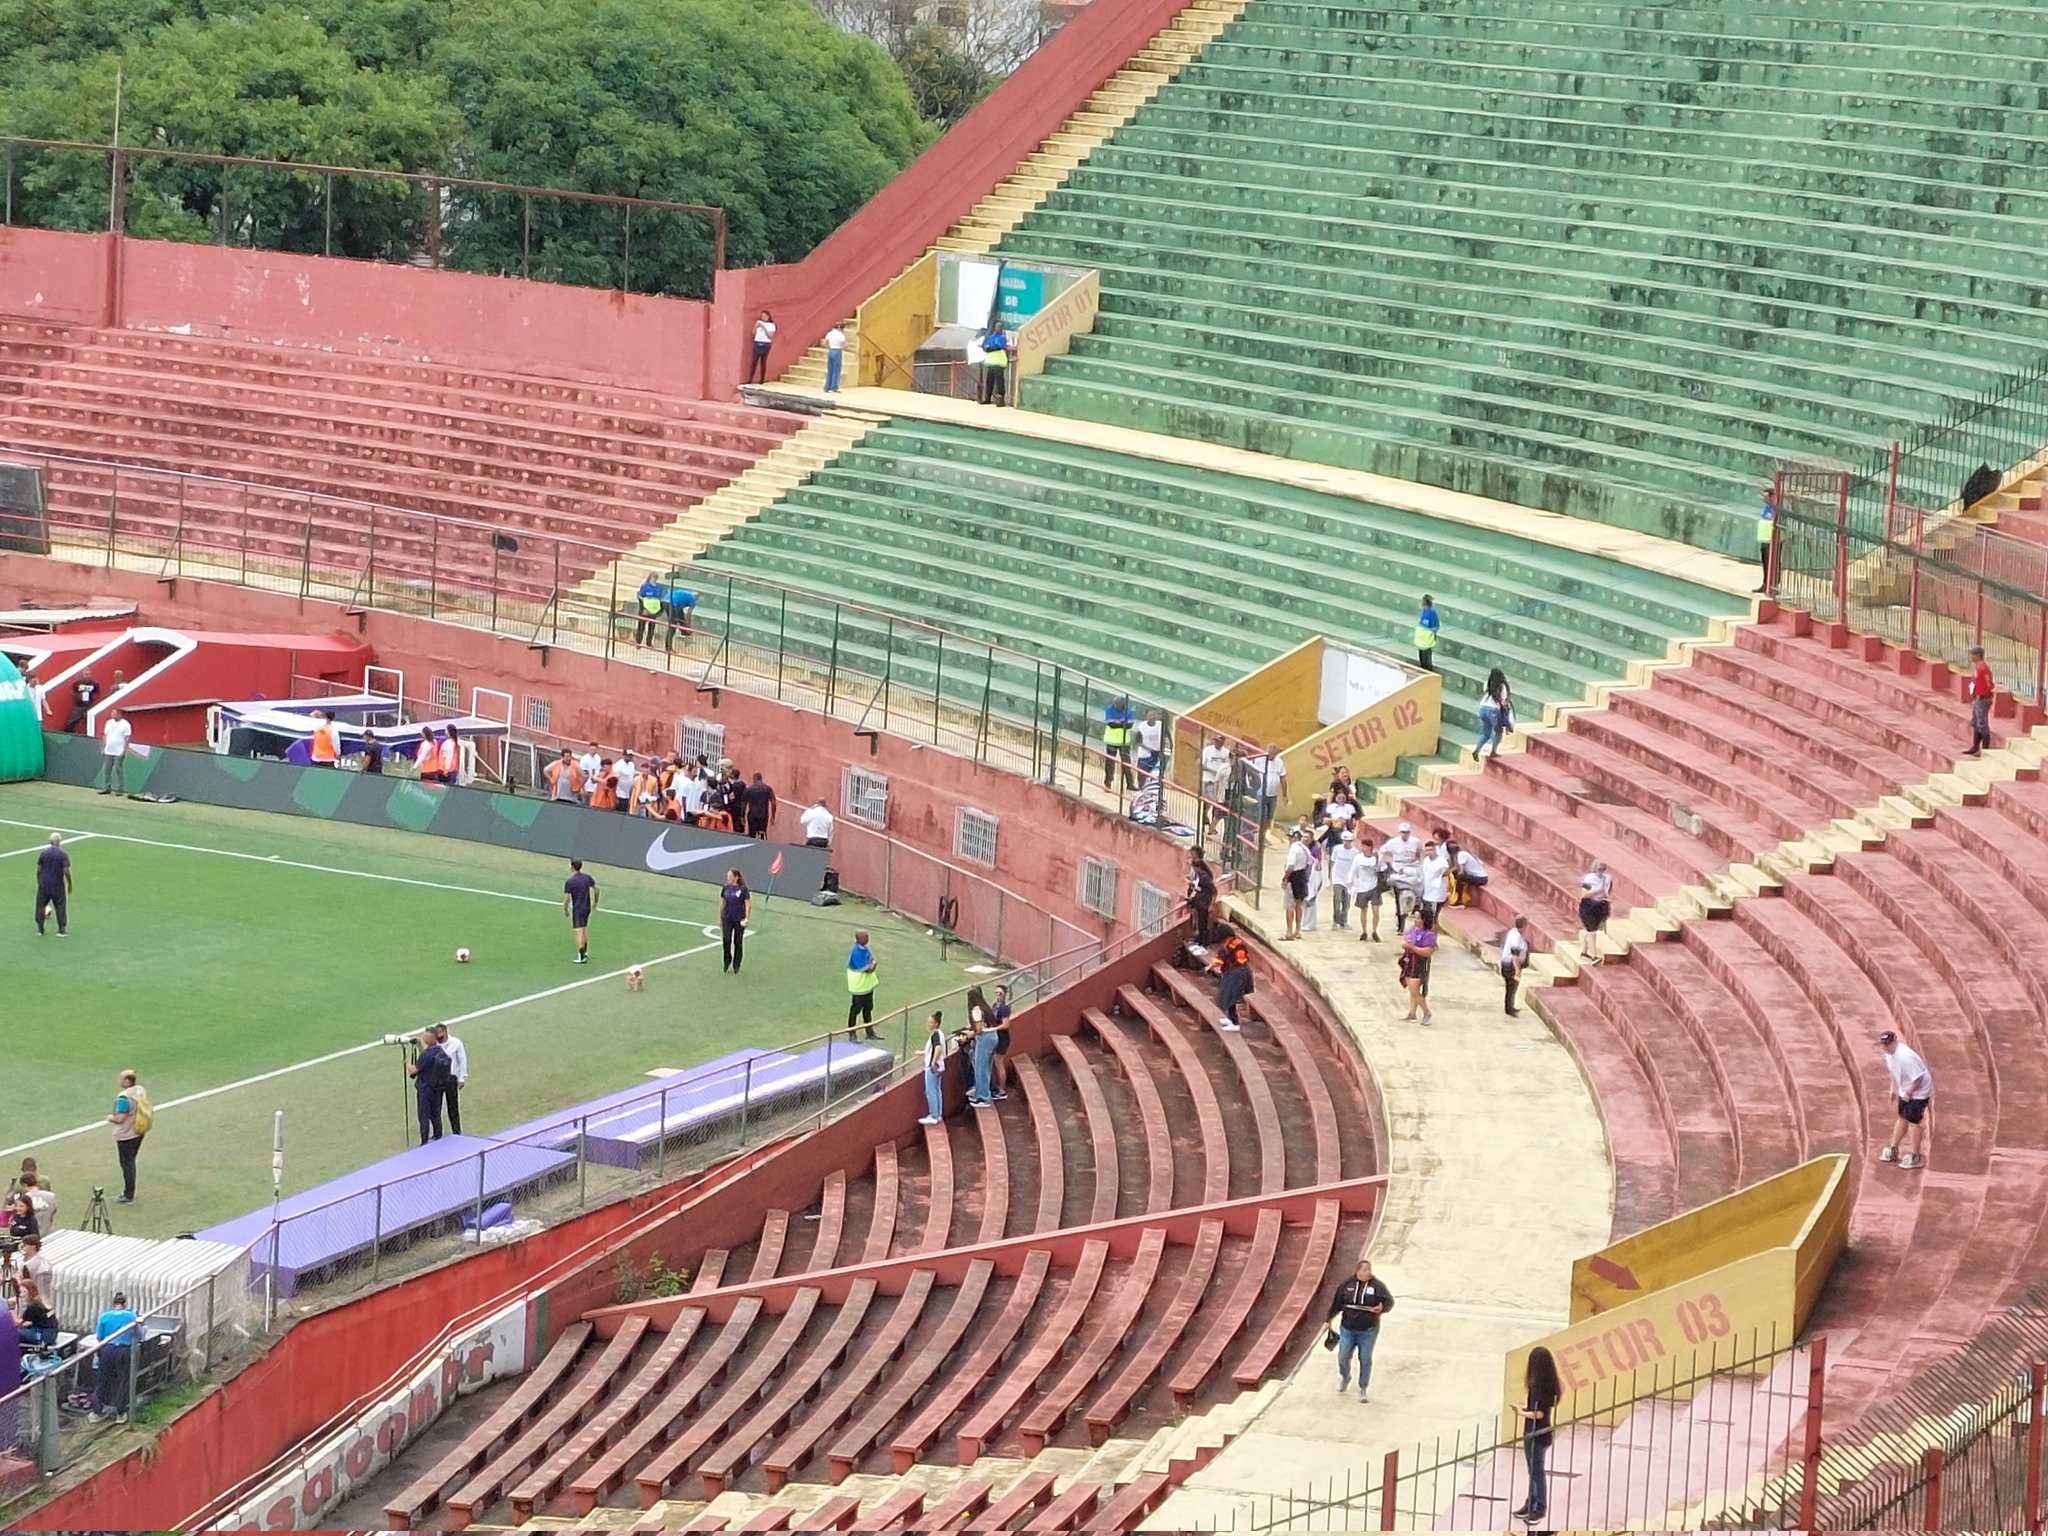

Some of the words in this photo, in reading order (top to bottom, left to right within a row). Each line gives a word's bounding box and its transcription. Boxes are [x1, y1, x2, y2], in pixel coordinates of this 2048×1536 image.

[1026, 303, 1073, 351] SETOR
[1074, 287, 1094, 314] 01
[1310, 716, 1387, 769] SETOR
[1392, 699, 1424, 730] 02
[1553, 1317, 1666, 1394] ETOR
[1676, 1293, 1731, 1345] 03
